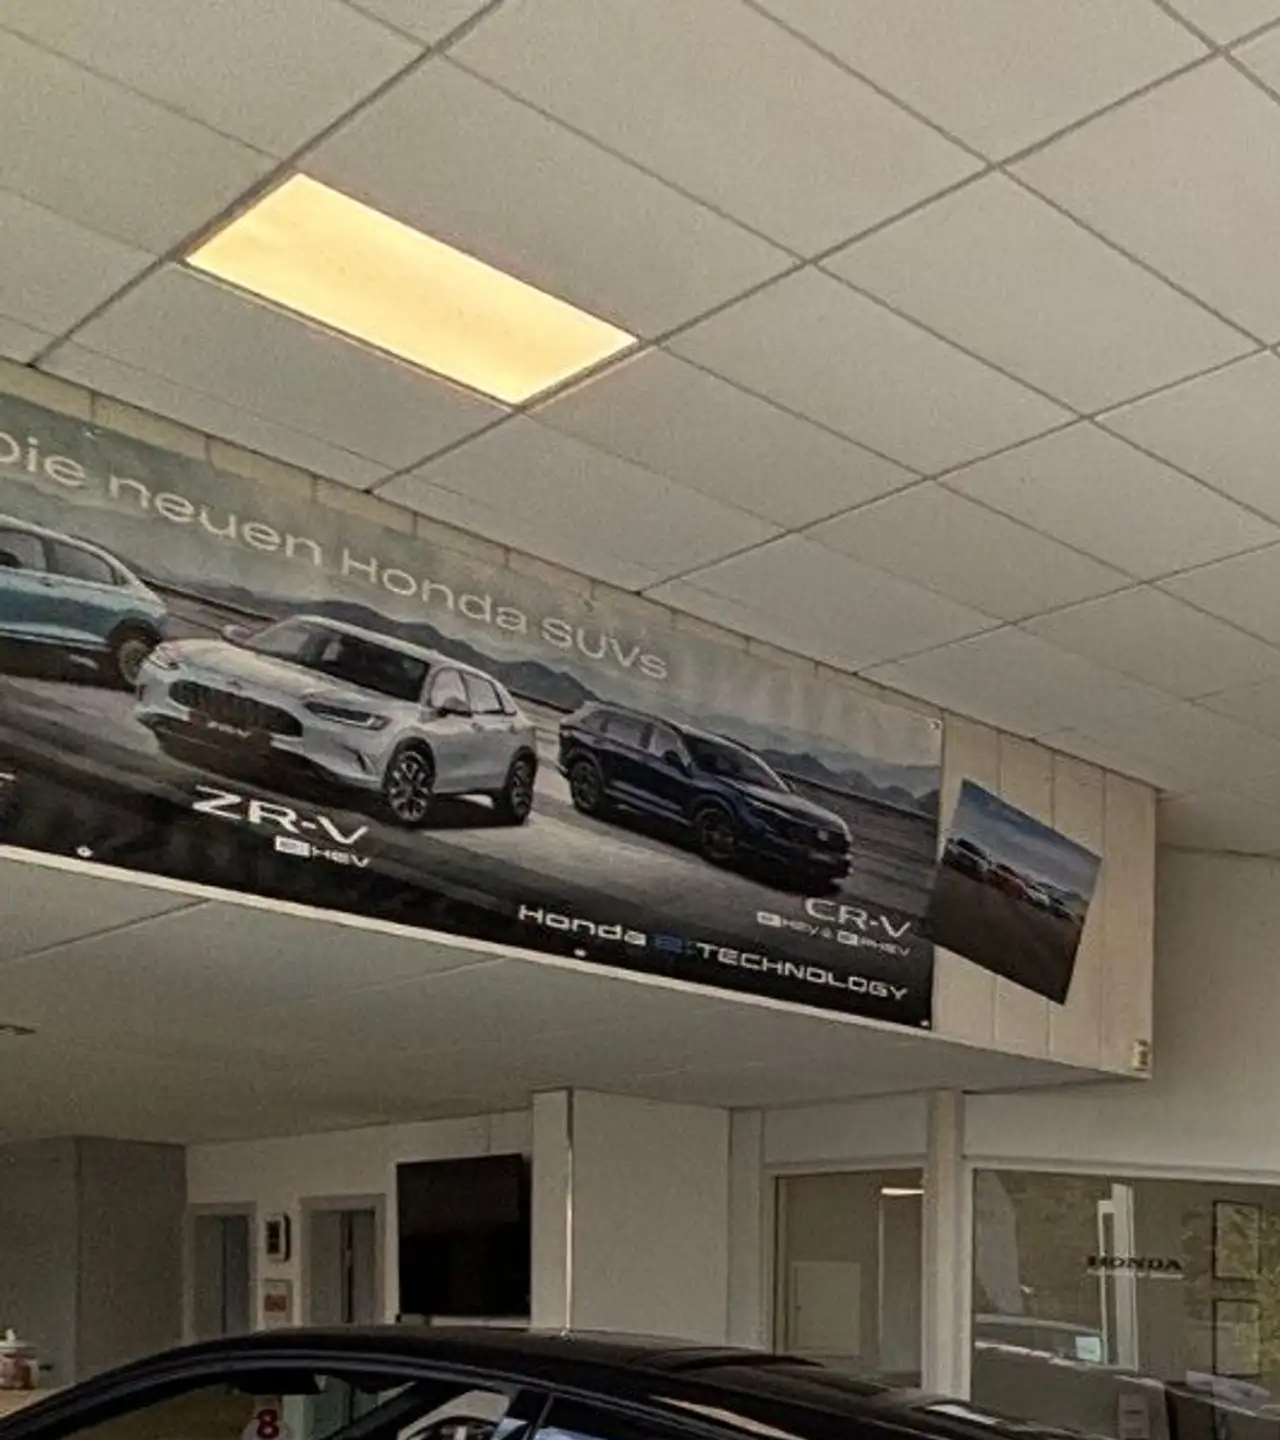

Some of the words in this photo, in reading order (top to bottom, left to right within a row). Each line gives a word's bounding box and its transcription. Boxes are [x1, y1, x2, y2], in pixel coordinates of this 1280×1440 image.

[109, 474, 322, 567] neuen
[342, 547, 528, 635] Honda
[543, 617, 668, 681] SUVs
[192, 784, 369, 844] ZR-V
[518, 904, 647, 947] Honda
[805, 897, 911, 938] CR-V
[1086, 1256, 1182, 1270] HONDA
[256, 1409, 279, 1440] 8
